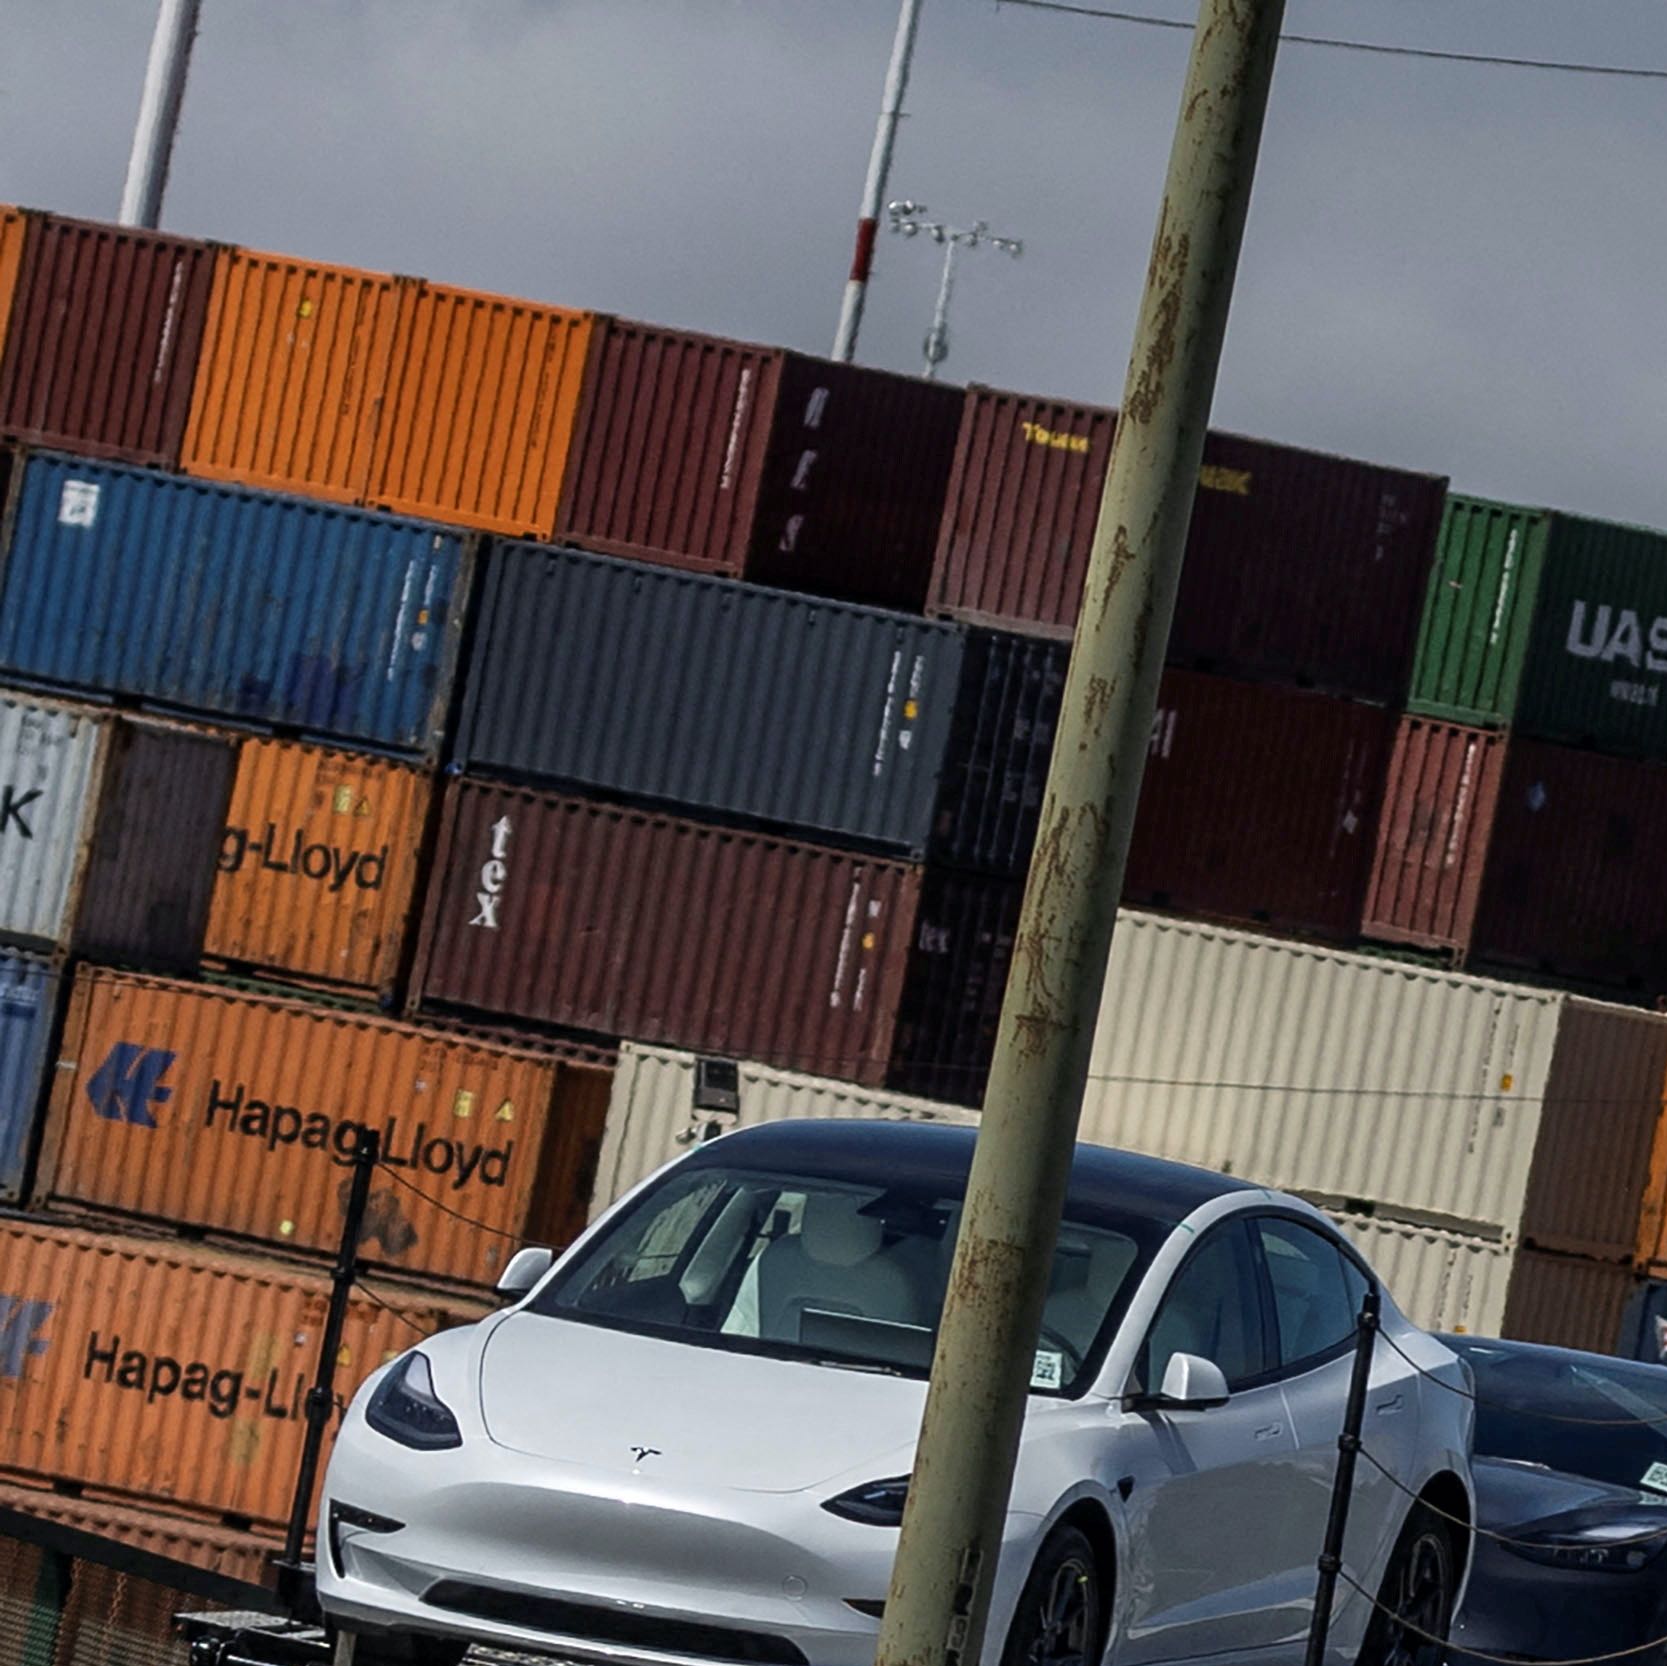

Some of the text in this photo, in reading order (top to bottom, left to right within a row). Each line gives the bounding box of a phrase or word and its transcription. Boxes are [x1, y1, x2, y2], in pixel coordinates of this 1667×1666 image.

[469, 815, 513, 928] tex
[205, 1078, 513, 1189] HapagLloyd
[83, 1331, 345, 1421] Hapag-Ll
